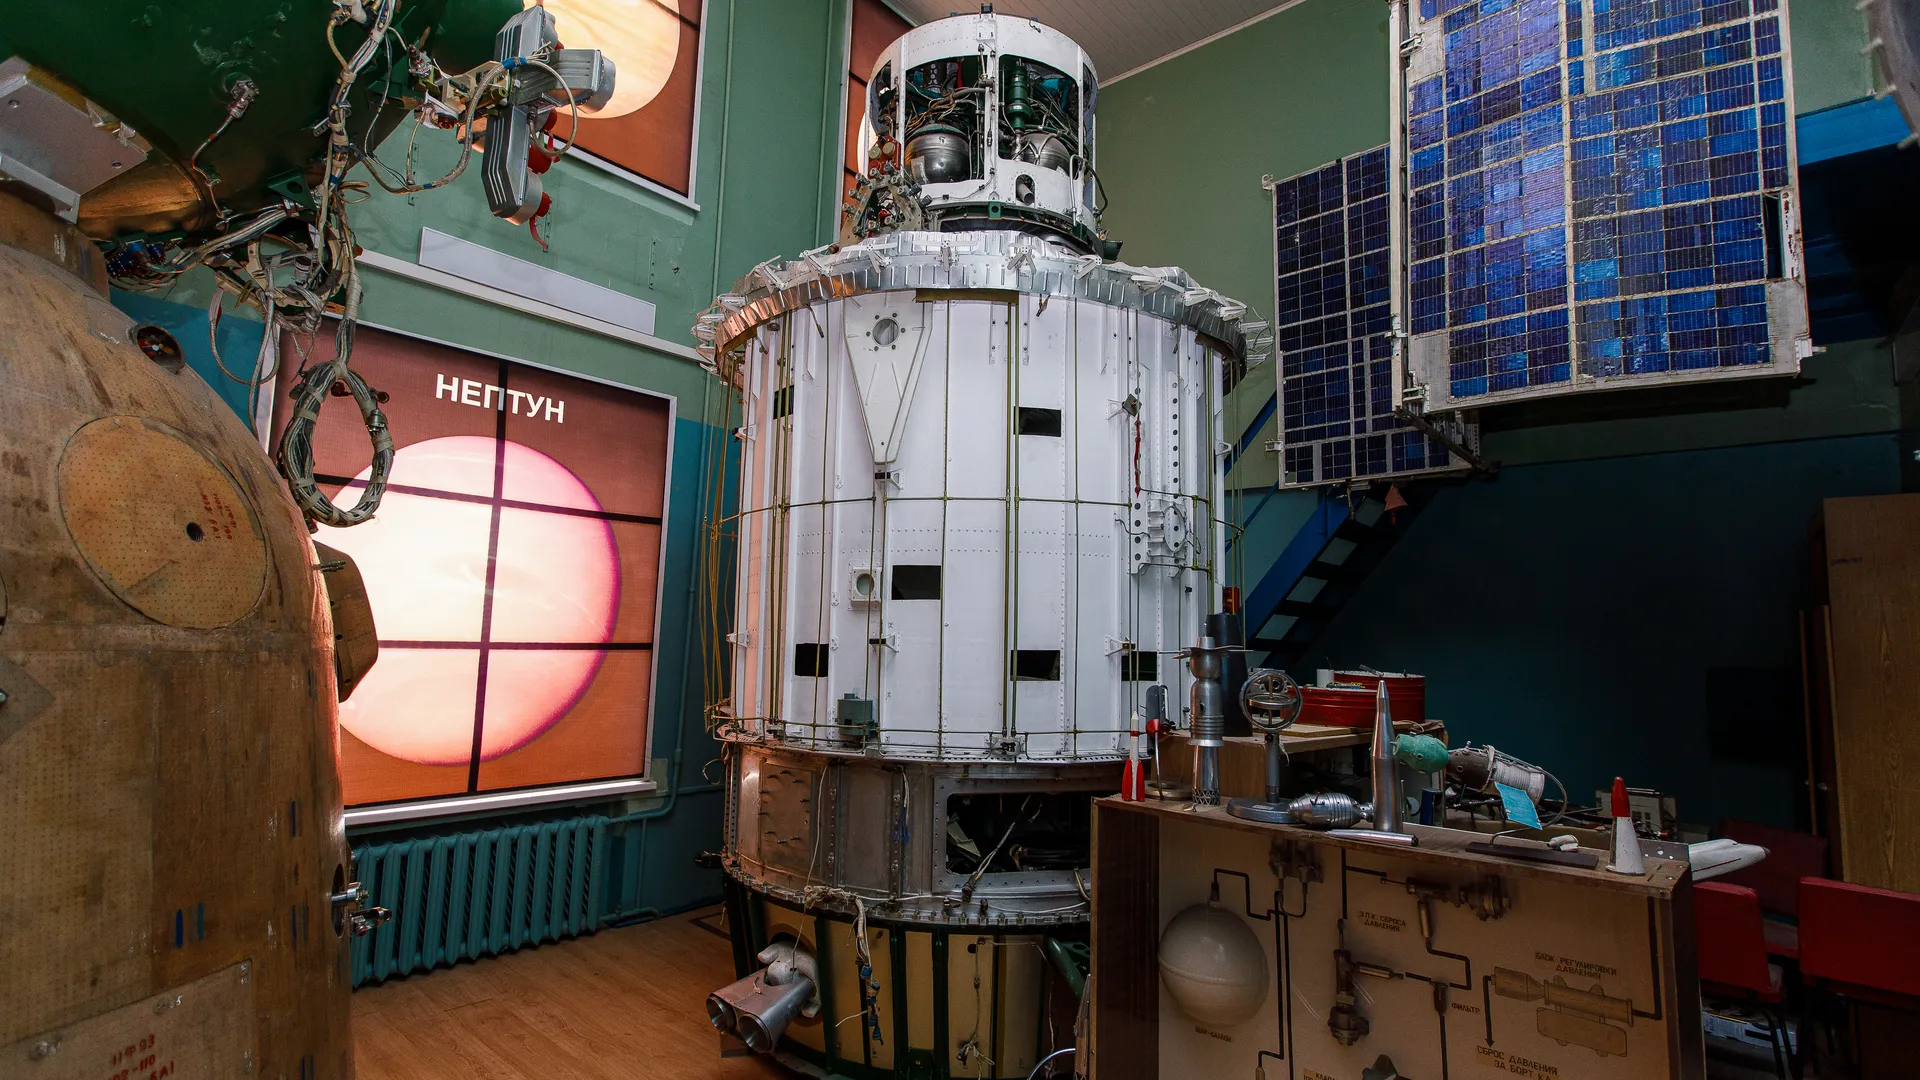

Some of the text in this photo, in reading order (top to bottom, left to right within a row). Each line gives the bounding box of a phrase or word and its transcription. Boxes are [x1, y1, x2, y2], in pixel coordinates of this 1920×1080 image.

[435, 373, 565, 424] НЕПТУН
[1363, 919, 1401, 932] ДАВЛЕНИЯ
[1535, 952, 1617, 976] БЛОК РЕГУЛИРОВКИ
[1555, 964, 1602, 980] ДАВЛЕНИЯ
[1451, 1002, 1481, 1014] ФИЛЬТР
[1477, 1045, 1559, 1076] СБРОС ДАВЛЕНИЯ
[1494, 1060, 1506, 1071] ЗА
[1510, 1064, 1534, 1078] БОРТ
